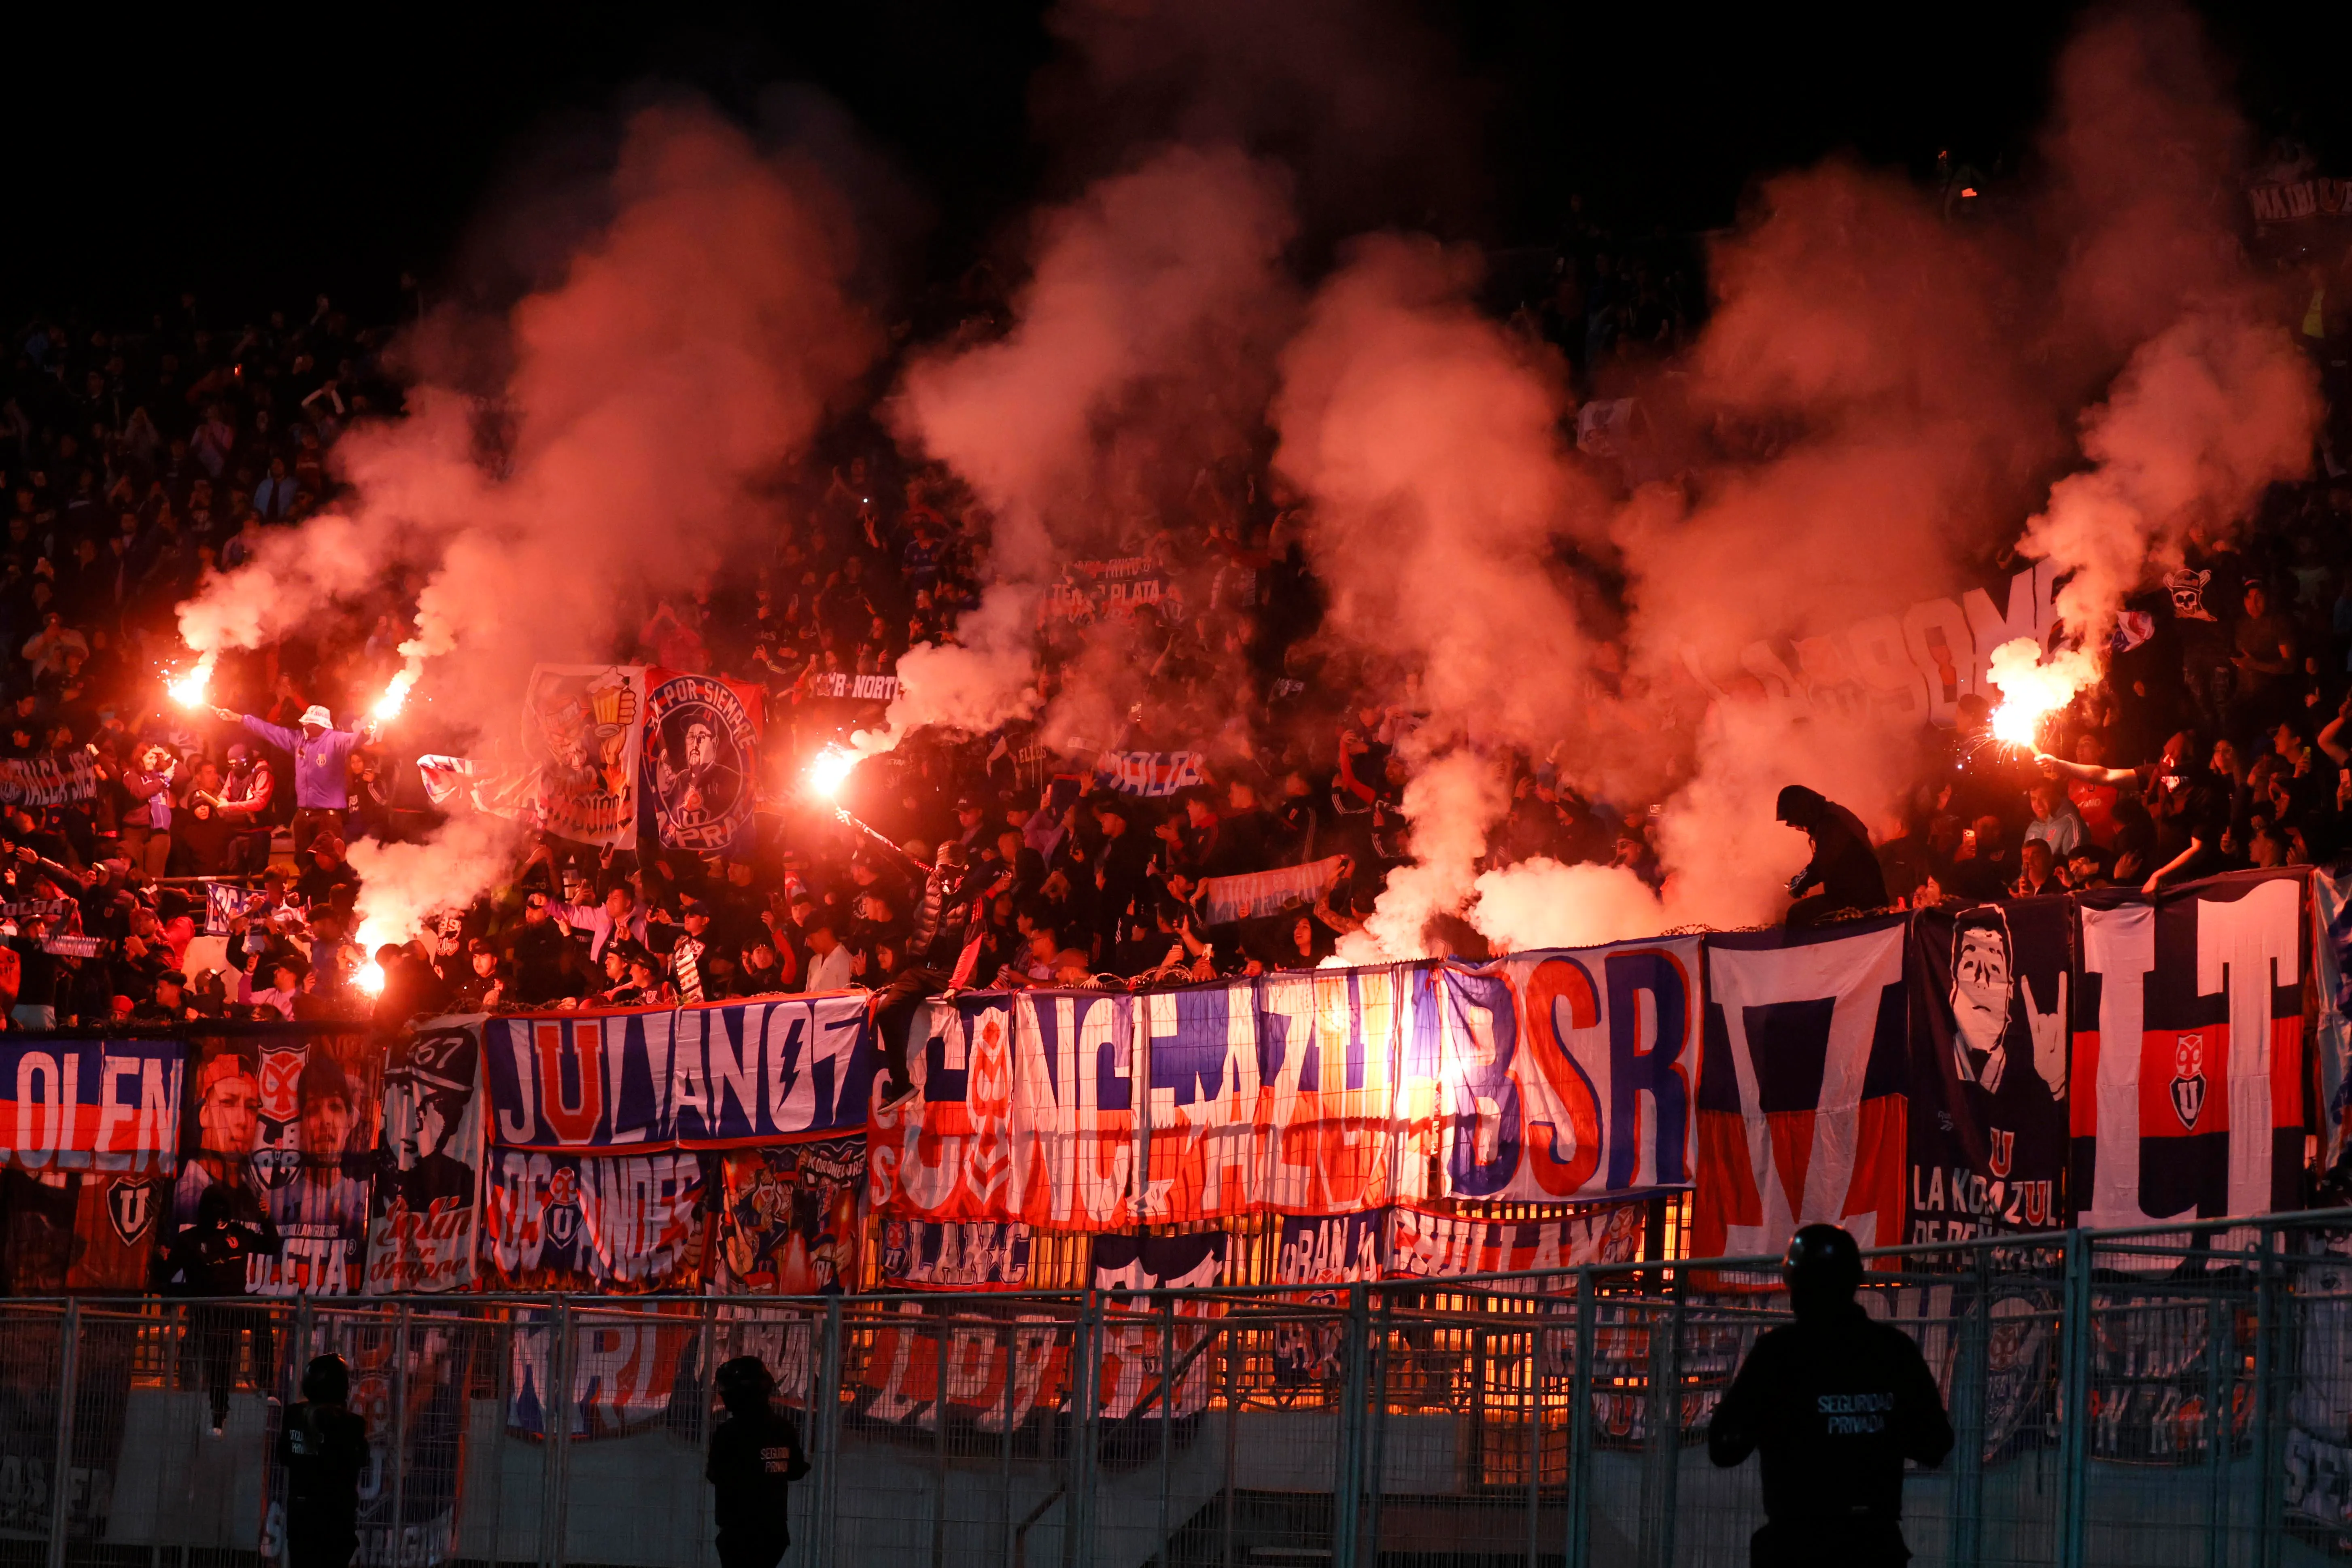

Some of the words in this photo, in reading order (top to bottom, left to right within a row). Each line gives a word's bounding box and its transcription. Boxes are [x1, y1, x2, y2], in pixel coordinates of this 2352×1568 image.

[1110, 579, 1160, 606] PLATA
[664, 679, 698, 708] POR
[704, 681, 758, 749] SIEMPRE
[1913, 1163, 1945, 1211] LA
[1817, 1392, 1894, 1413] SEGURIDAD
[1827, 1415, 1885, 1434] PRIVADA
